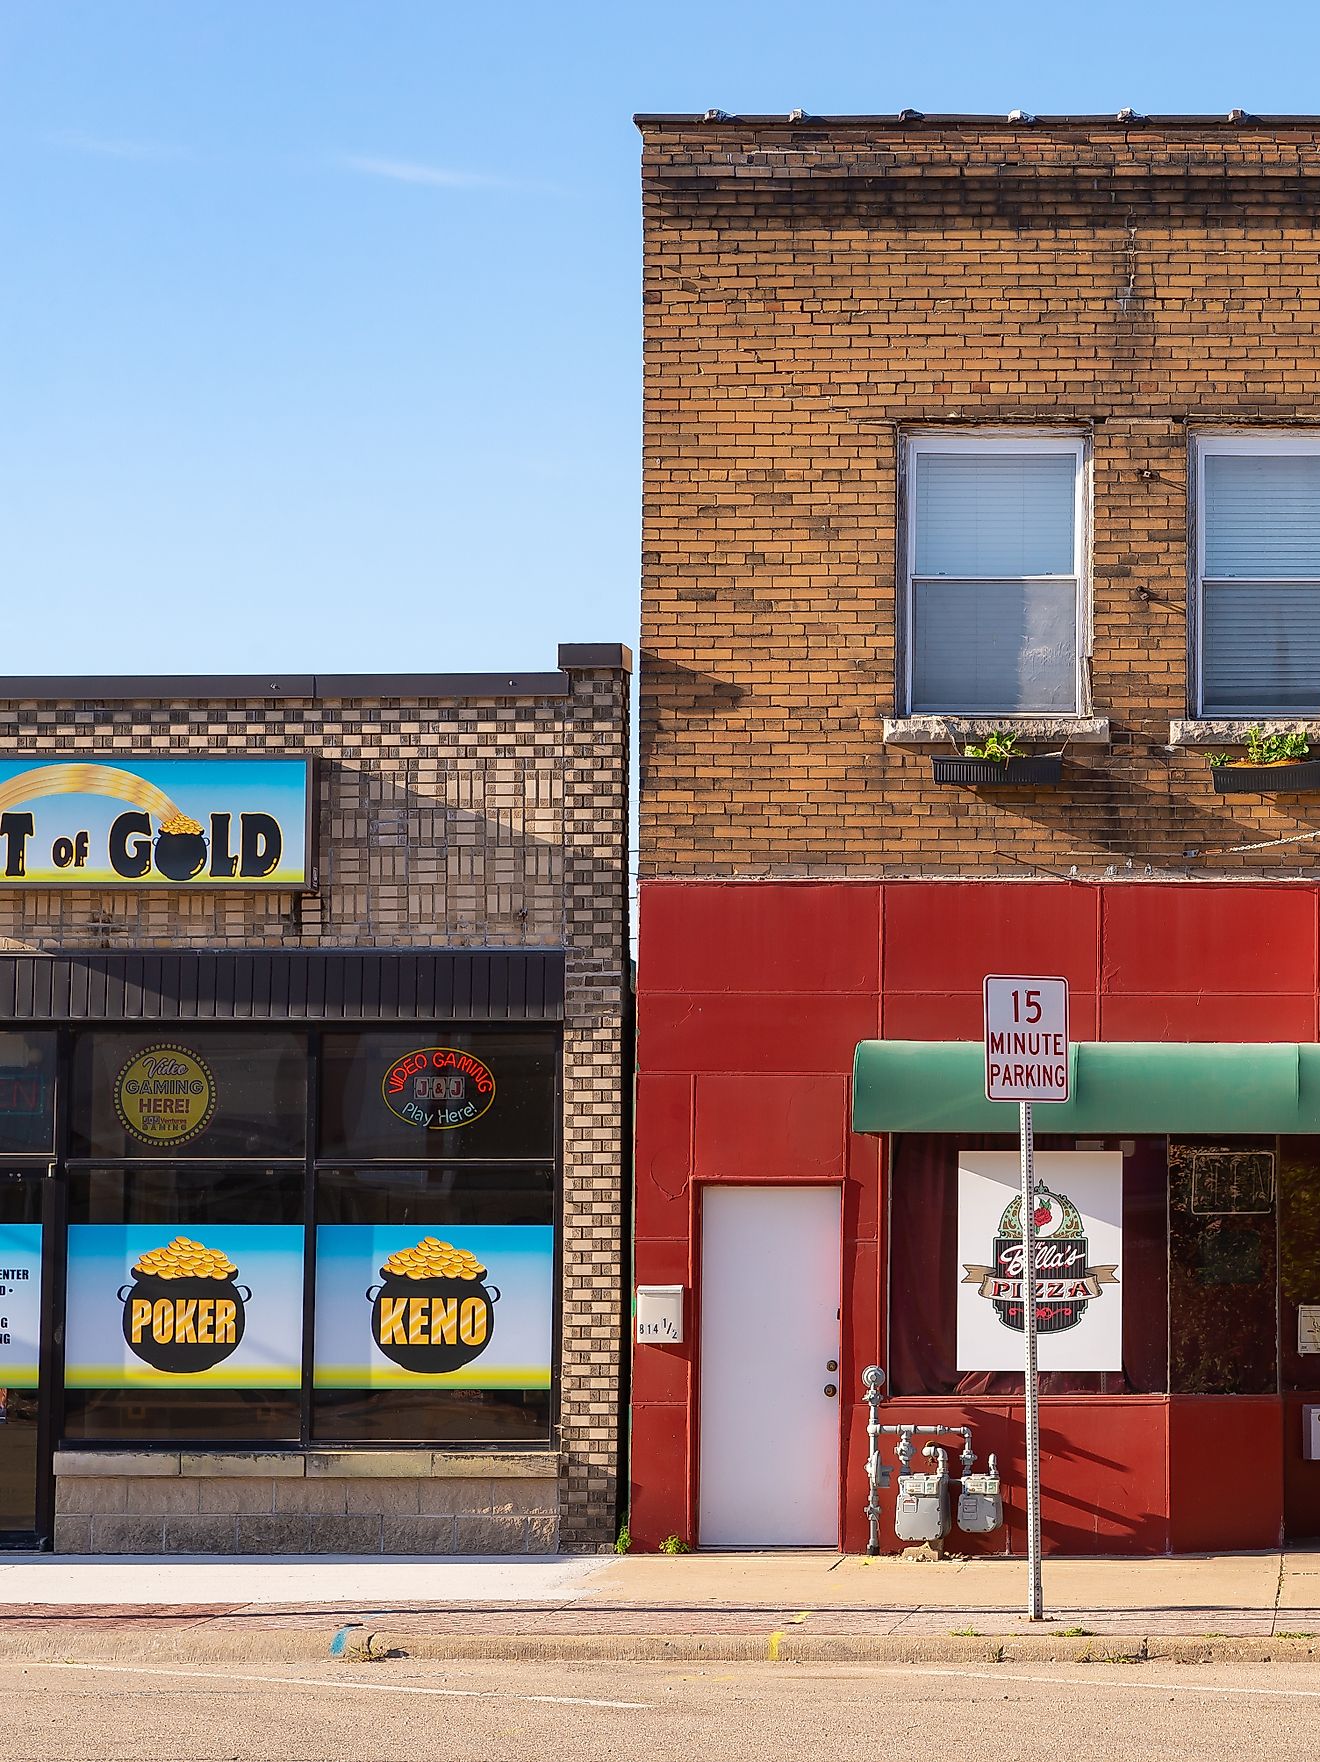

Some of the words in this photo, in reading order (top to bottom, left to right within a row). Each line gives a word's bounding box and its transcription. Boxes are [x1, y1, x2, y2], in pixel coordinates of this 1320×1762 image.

[1011, 990, 1042, 1024] 15
[990, 1031, 1064, 1056] MINUTE
[141, 1057, 189, 1079] Video
[388, 1053, 428, 1094] VIDEO
[432, 1051, 494, 1094] GAMING
[990, 1063, 1065, 1088] PARKING
[125, 1079, 204, 1095] GAMING
[416, 1080, 428, 1097] J
[434, 1082, 444, 1095] &
[450, 1080, 461, 1097] J
[139, 1098, 190, 1114] HERE!
[401, 1102, 434, 1127] Play
[438, 1101, 478, 1124] Here!
[1000, 1244, 1086, 1277] Blla's
[0, 1269, 29, 1280] NTER
[991, 1280, 1093, 1298] PIZZA
[131, 1298, 237, 1345] POKER
[379, 1297, 488, 1346] KENO
[639, 1323, 658, 1335] 814
